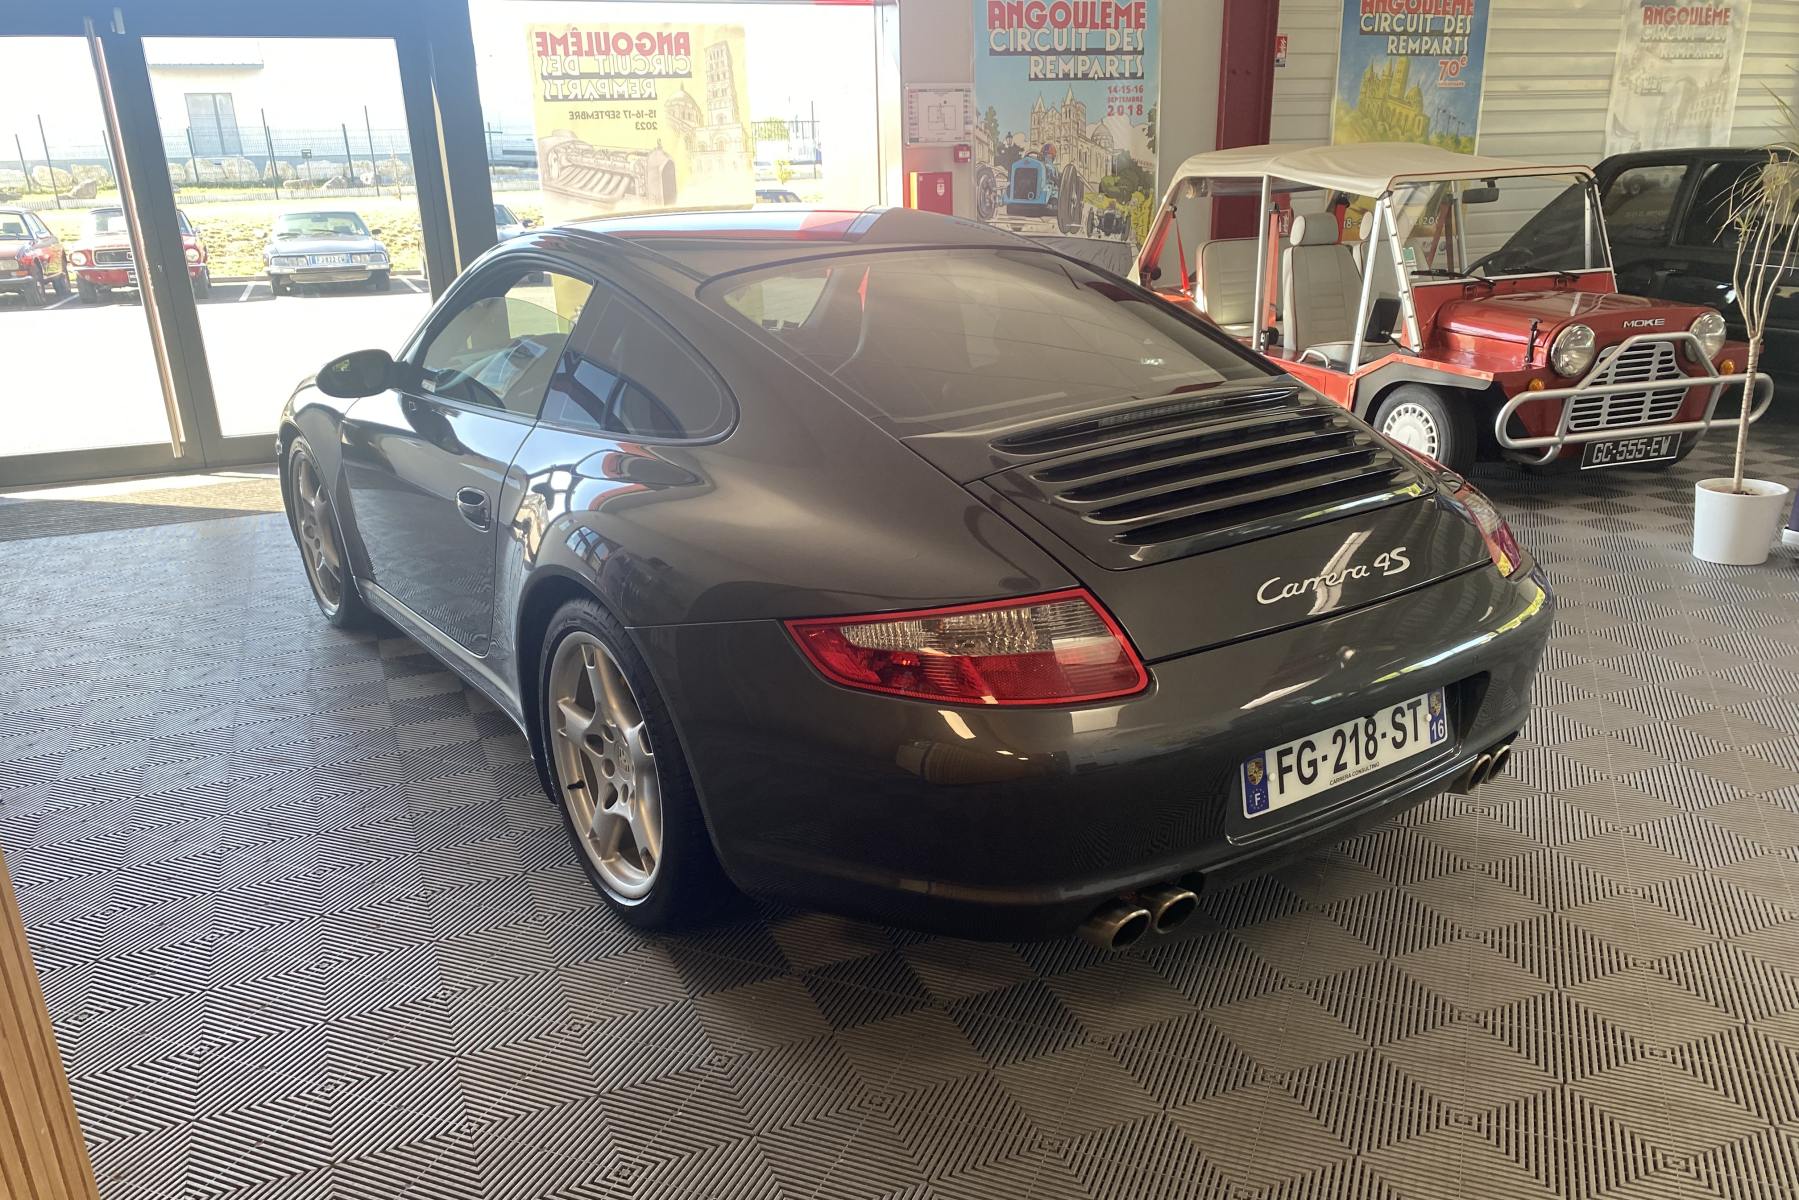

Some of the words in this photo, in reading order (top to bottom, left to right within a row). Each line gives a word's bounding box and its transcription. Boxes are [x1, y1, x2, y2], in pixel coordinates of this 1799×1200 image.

[1361, 13, 1434, 32] CIRCUIT
[1443, 14, 1472, 34] DES
[989, 27, 1090, 52] CIRCUIT
[1105, 28, 1145, 52] DES
[1387, 36, 1468, 55] REMPARTS
[1029, 55, 1145, 80] REMPARTS
[1107, 104, 1143, 116] 2018
[1623, 318, 1665, 328] MOKE
[1592, 436, 1672, 463] GC-555-EW
[1257, 564, 1370, 605] Carrera
[1374, 546, 1411, 577] 4S
[1431, 719, 1445, 740] 16
[1276, 698, 1422, 795] FG-218-ST
[1254, 792, 1262, 806] F
